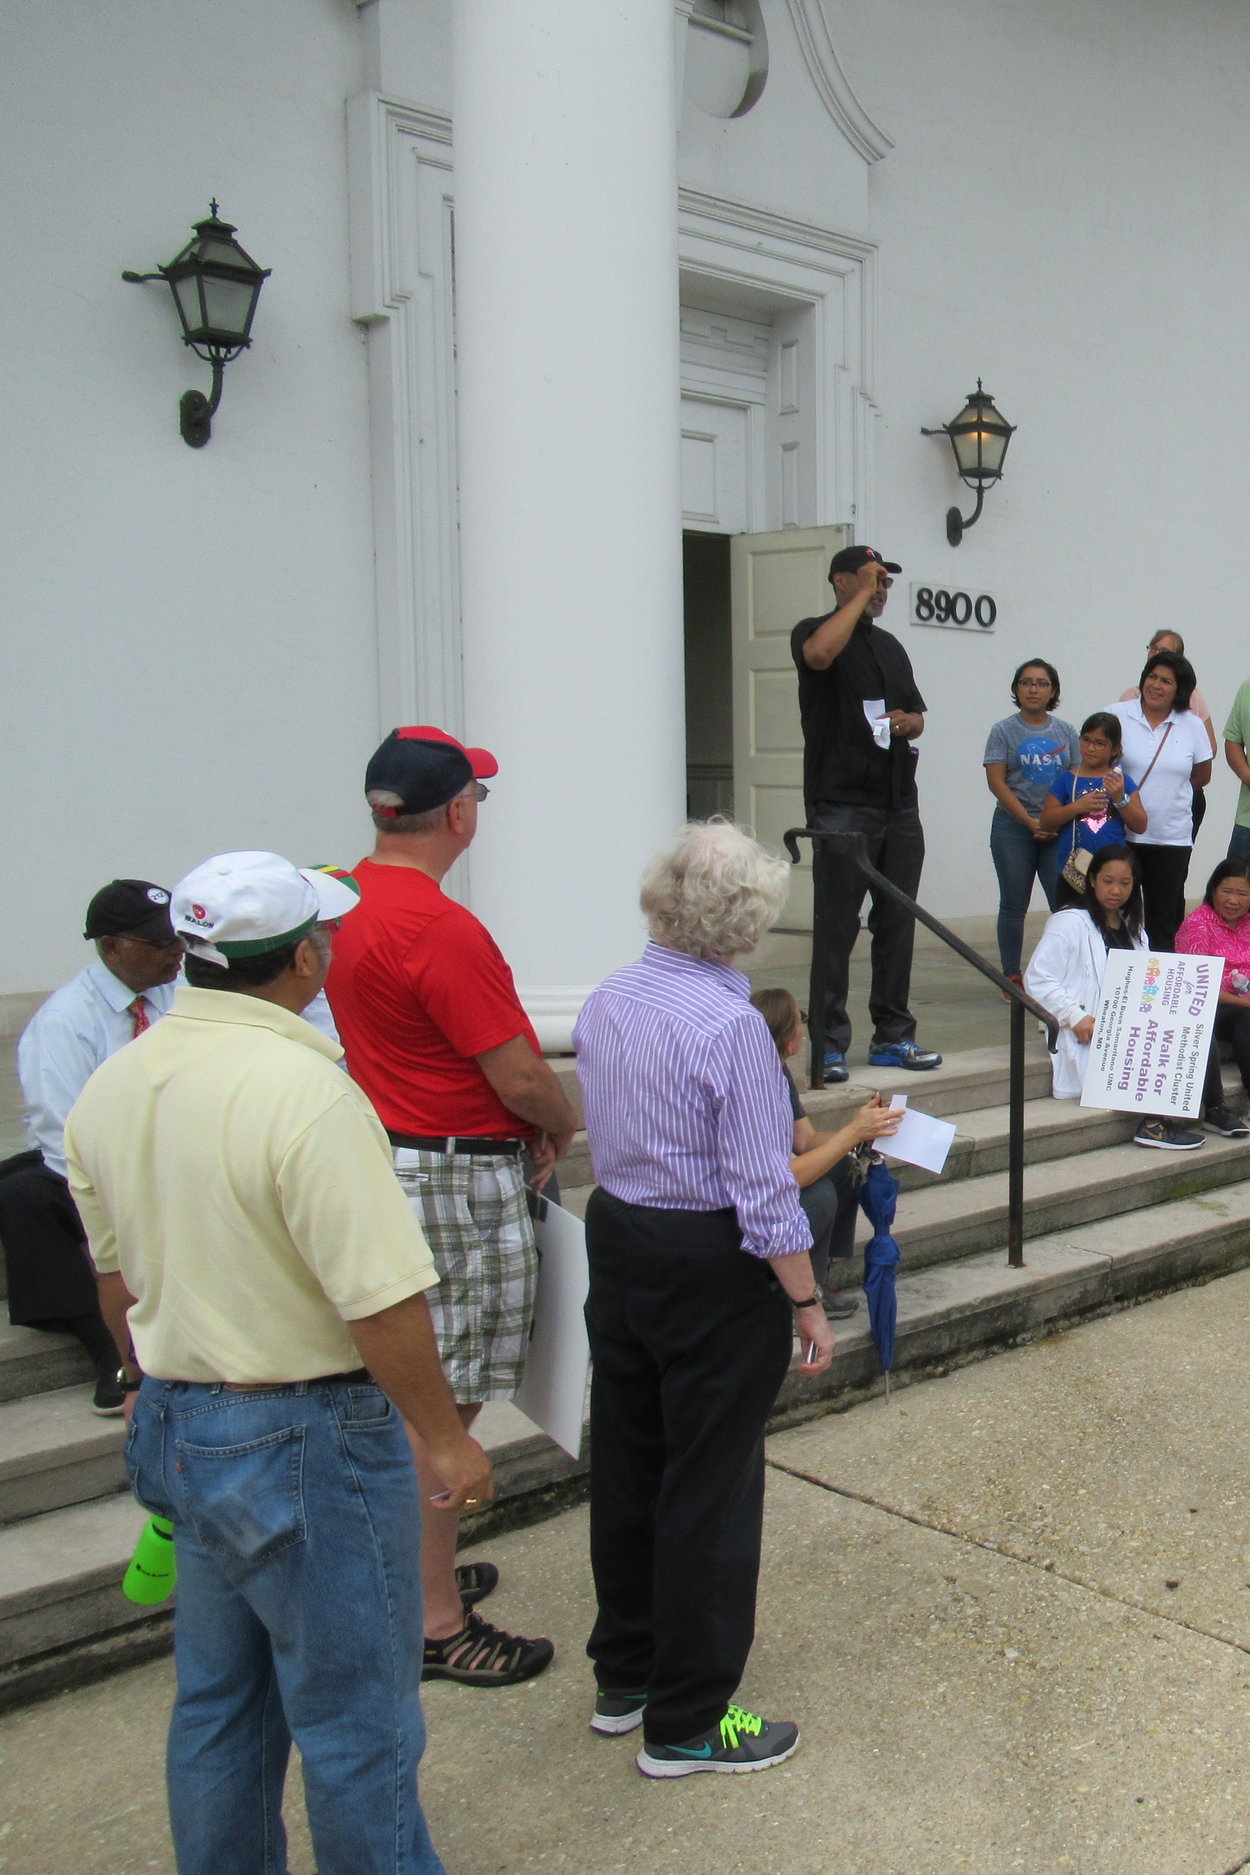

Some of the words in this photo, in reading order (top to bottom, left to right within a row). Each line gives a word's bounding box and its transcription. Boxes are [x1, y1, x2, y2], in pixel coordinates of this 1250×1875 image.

[916, 587, 997, 628] 8900
[1019, 753, 1063, 766] NASA
[1111, 986, 1122, 1010] 10700
[1161, 968, 1176, 1006] HOUSING
[1168, 960, 1186, 1015] AFFORDABLE
[1182, 980, 1195, 995] for
[1188, 963, 1210, 1017] UNITED
[1097, 999, 1110, 1035] Wheaton,
[1105, 1010, 1117, 1041] Georgia
[1117, 1005, 1127, 1025] Buen
[1096, 1037, 1104, 1050] MD
[1109, 1026, 1123, 1072] Samaritano
[1157, 1029, 1175, 1068] Walk
[1175, 1026, 1191, 1071] Methodist
[1192, 1023, 1205, 1049] Silver
[1100, 1042, 1111, 1072] Avenue
[1117, 1026, 1142, 1091] Housing
[1134, 1019, 1159, 1102] Affordable
[1185, 1050, 1200, 1080] Spring
[1105, 1073, 1114, 1092] UMC
[1153, 1072, 1167, 1096] for
[1170, 1072, 1183, 1106] Cluster
[1181, 1081, 1195, 1112] United
